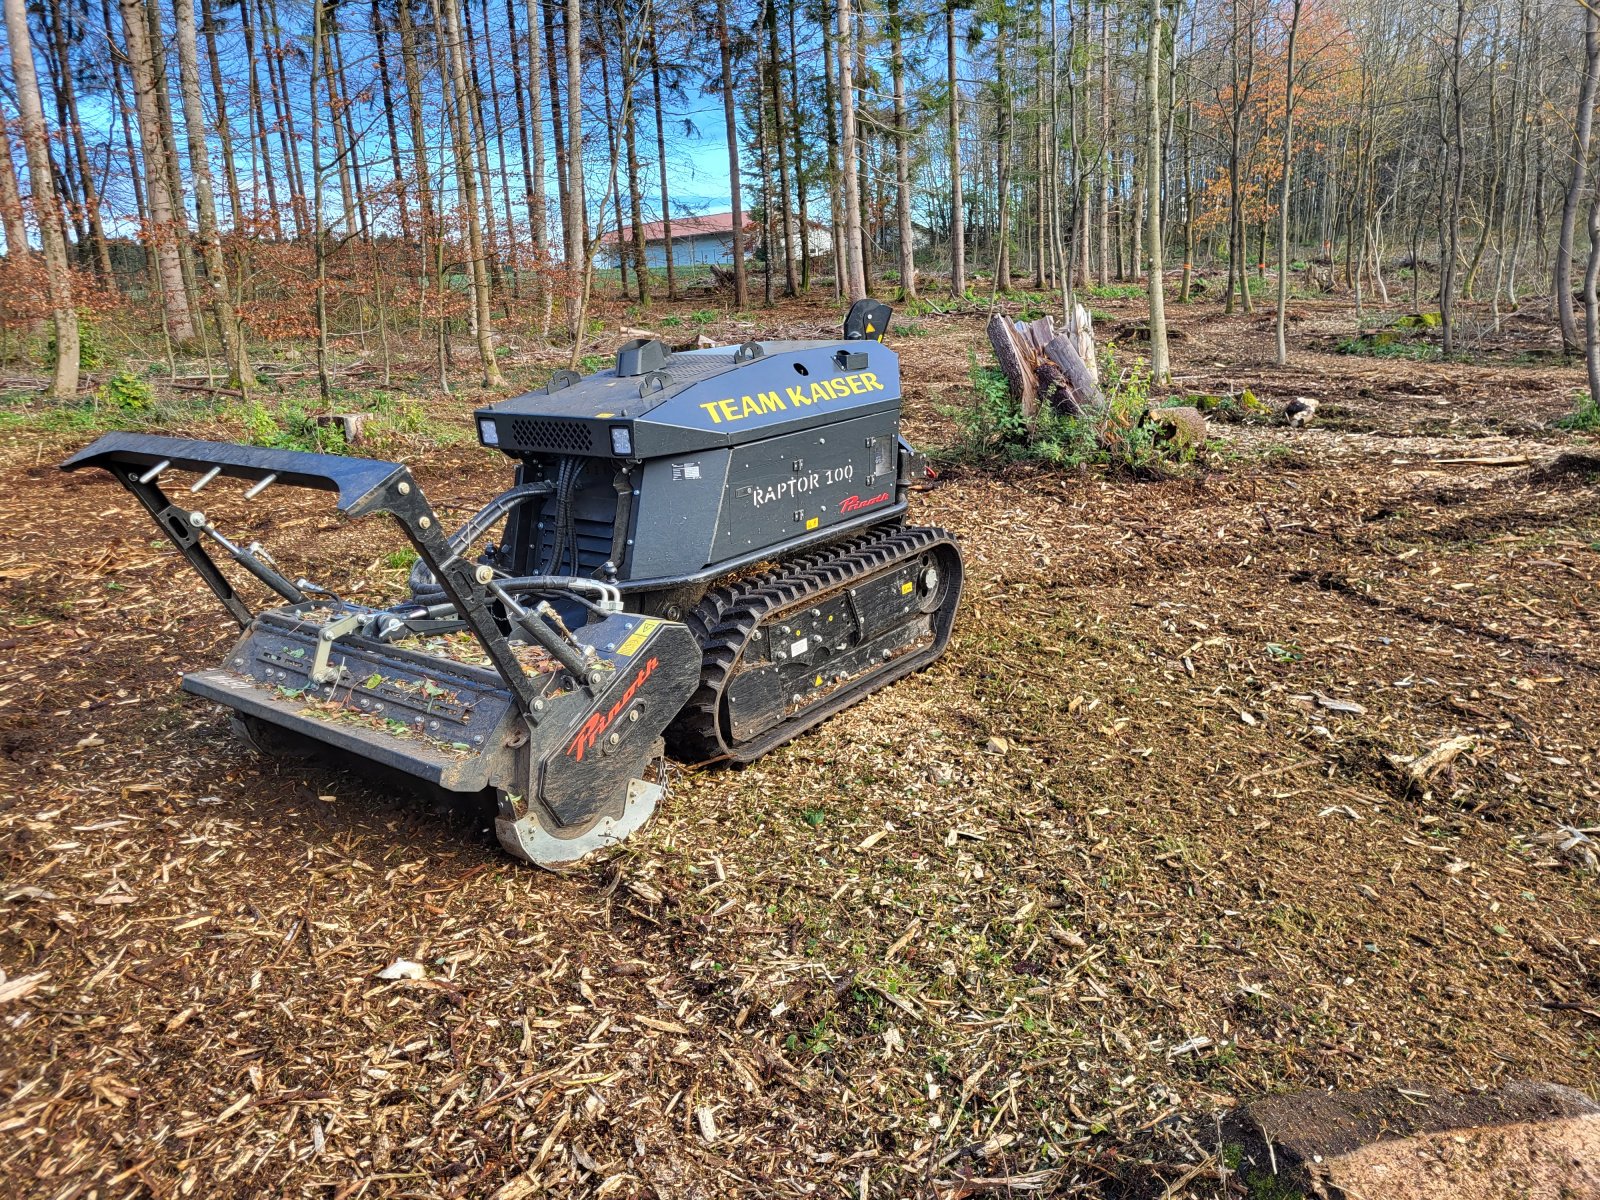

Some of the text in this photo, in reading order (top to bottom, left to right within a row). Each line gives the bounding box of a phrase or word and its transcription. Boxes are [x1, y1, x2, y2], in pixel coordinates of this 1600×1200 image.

[700, 372, 885, 424] TEAM KAISER
[753, 463, 853, 508] RAPTOR 100
[566, 656, 660, 763] Prinoth
